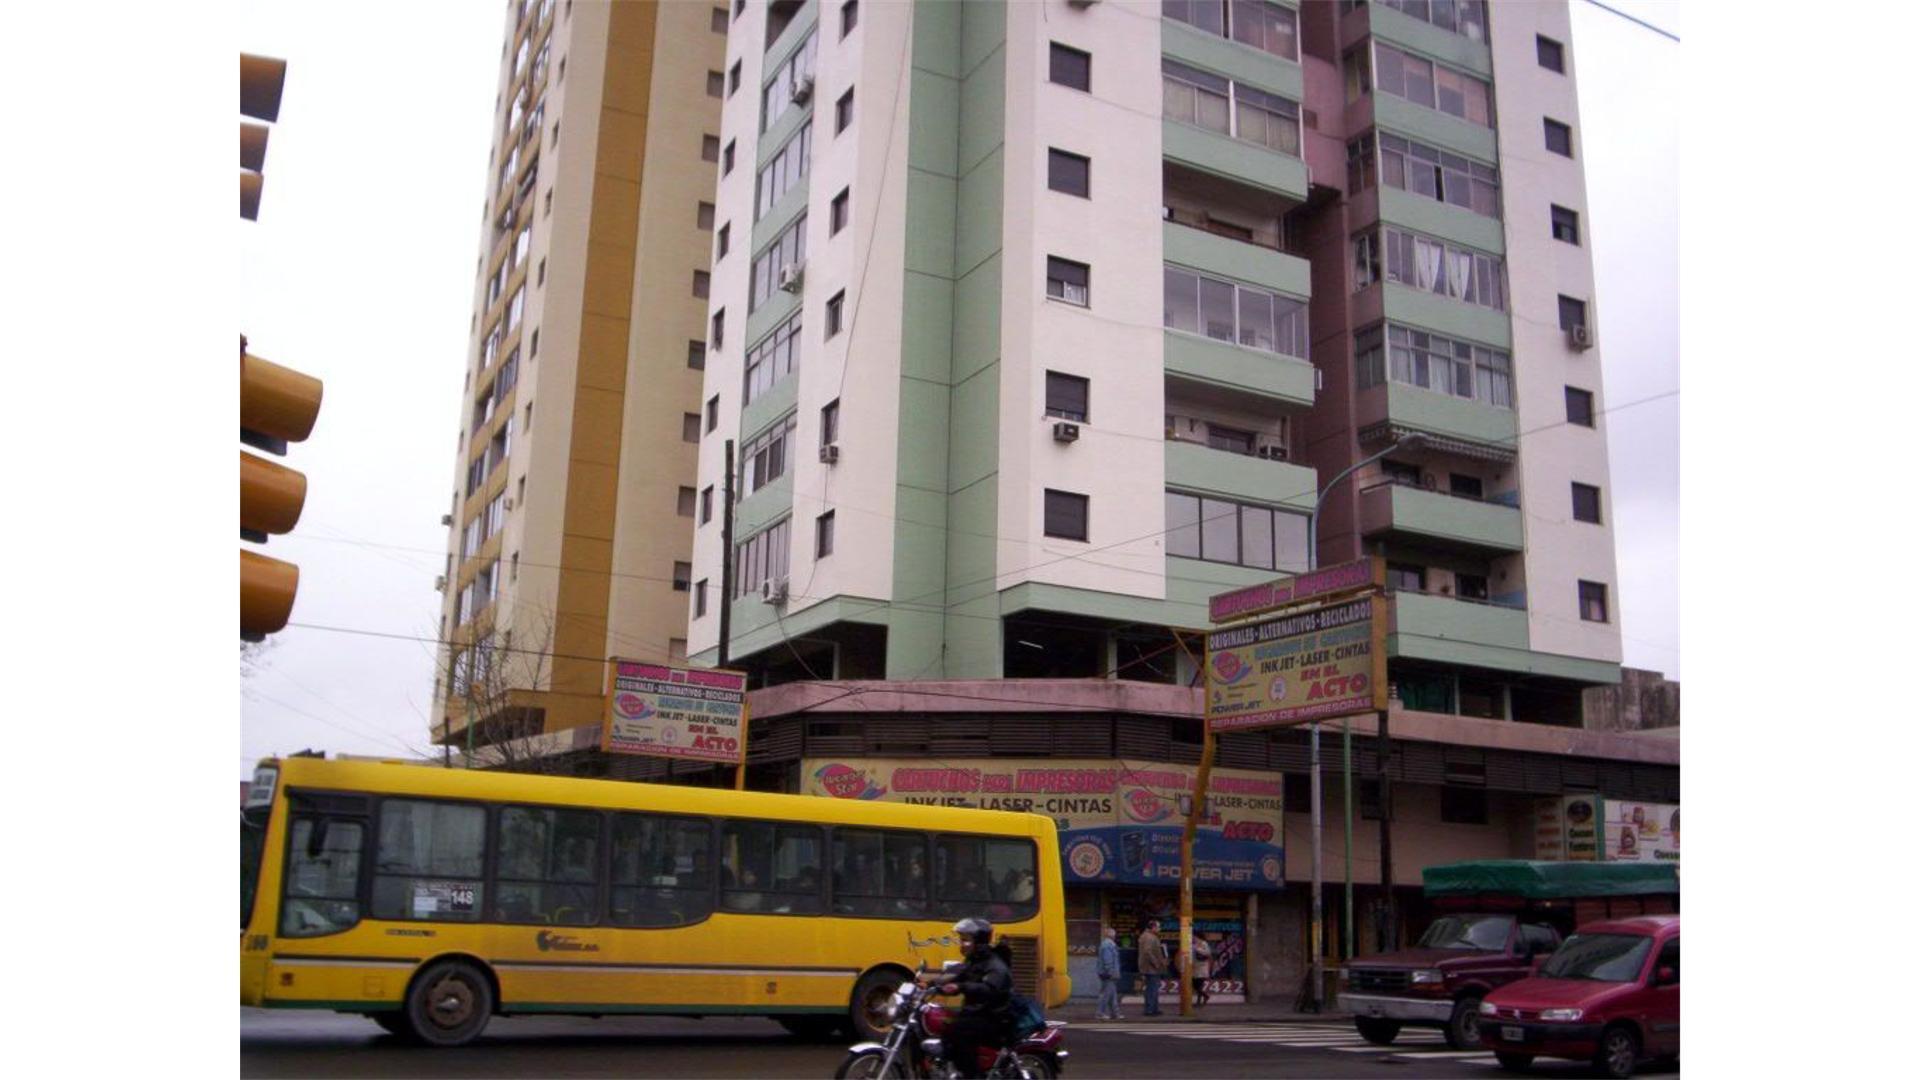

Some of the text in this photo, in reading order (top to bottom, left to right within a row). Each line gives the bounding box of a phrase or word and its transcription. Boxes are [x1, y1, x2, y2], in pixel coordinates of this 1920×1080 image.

[1209, 626, 1254, 649] ORIGINALES
[1258, 614, 1316, 641] ALTERNATIVOS
[1320, 601, 1371, 627] RECICLADOS
[1260, 658, 1278, 675] INK
[1279, 655, 1295, 673] JET
[1300, 649, 1330, 668] LASER
[1334, 640, 1370, 661] CINTAS
[1306, 672, 1369, 701] ACTO
[1297, 696, 1372, 717] IMPRESORAS
[692, 735, 738, 751] ACTO
[1015, 768, 1116, 794] IMPRESORAS
[980, 799, 1033, 813] LASER
[1046, 798, 1112, 814] CINTAS
[1214, 794, 1245, 808] LASER
[1223, 820, 1275, 842] ACTO
[1224, 867, 1255, 882] JET
[451, 889, 475, 905] 148
